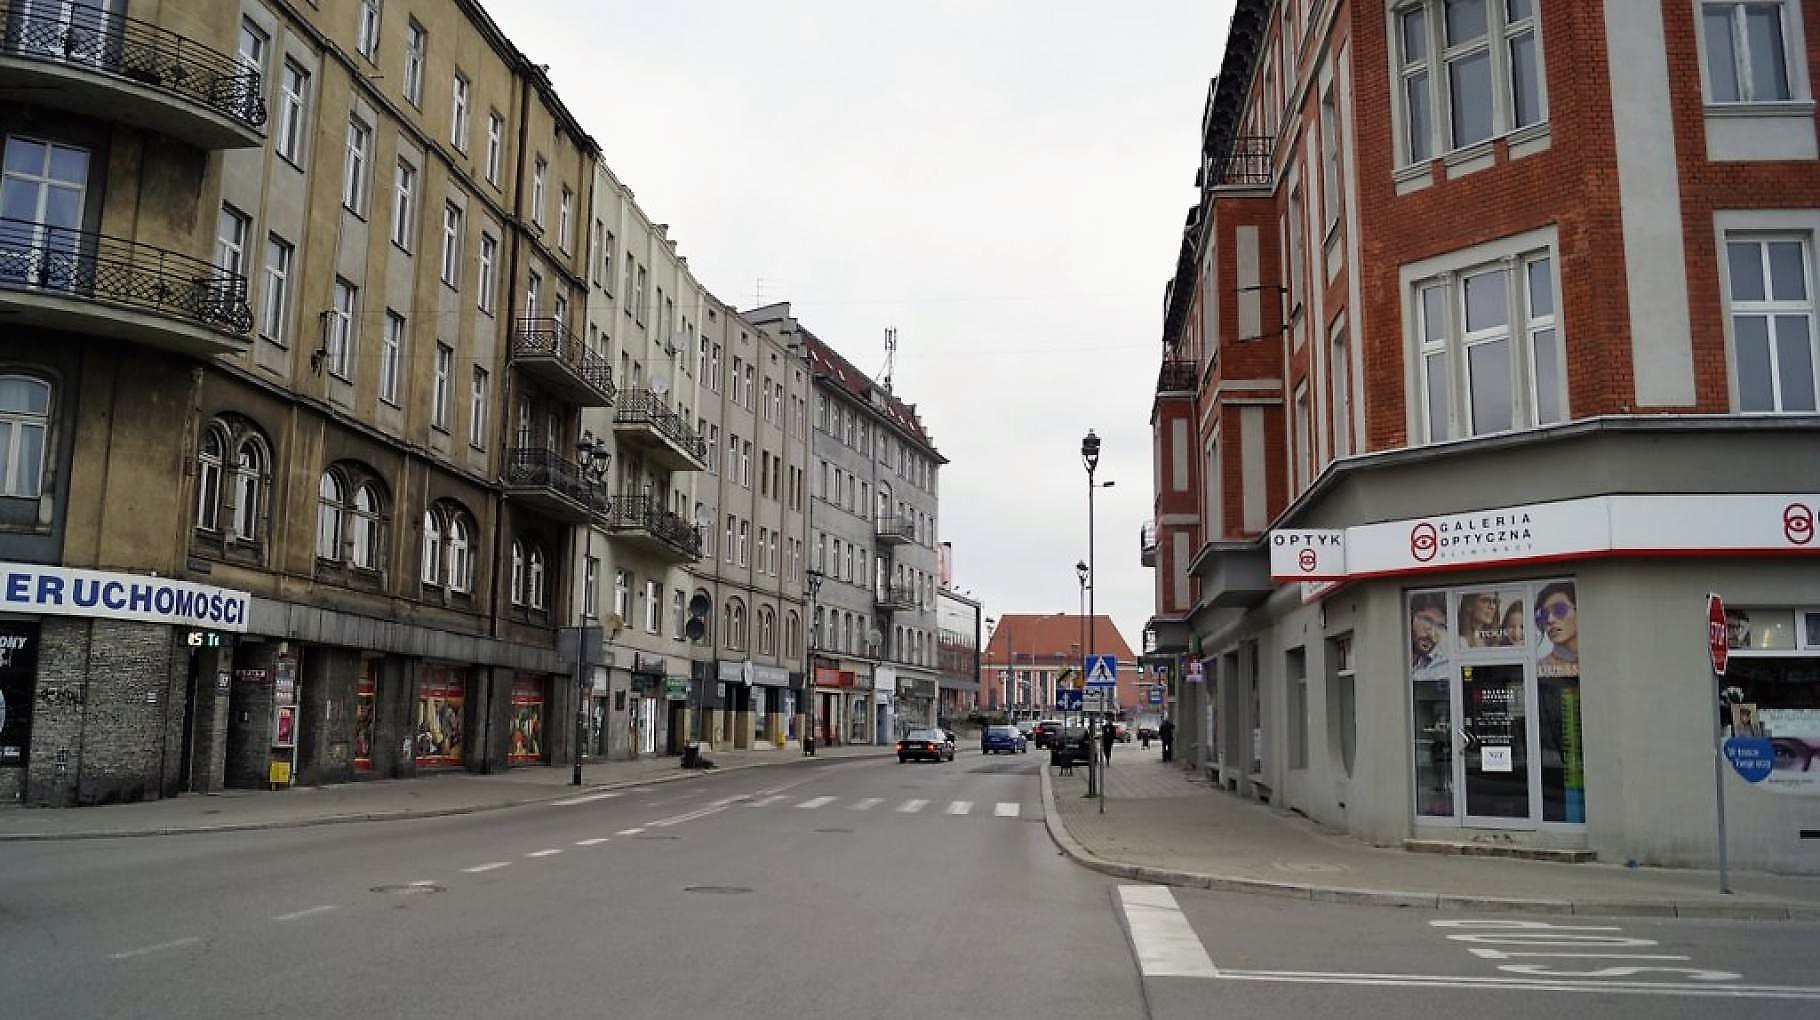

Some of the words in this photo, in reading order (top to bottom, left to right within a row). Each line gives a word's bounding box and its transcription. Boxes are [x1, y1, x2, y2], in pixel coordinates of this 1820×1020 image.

[1440, 512, 1531, 532] GALERIA
[1273, 534, 1342, 546] OPTYK
[1440, 527, 1532, 547] OPTYCZNA
[5, 572, 245, 625] ERUCHOMOŚCI
